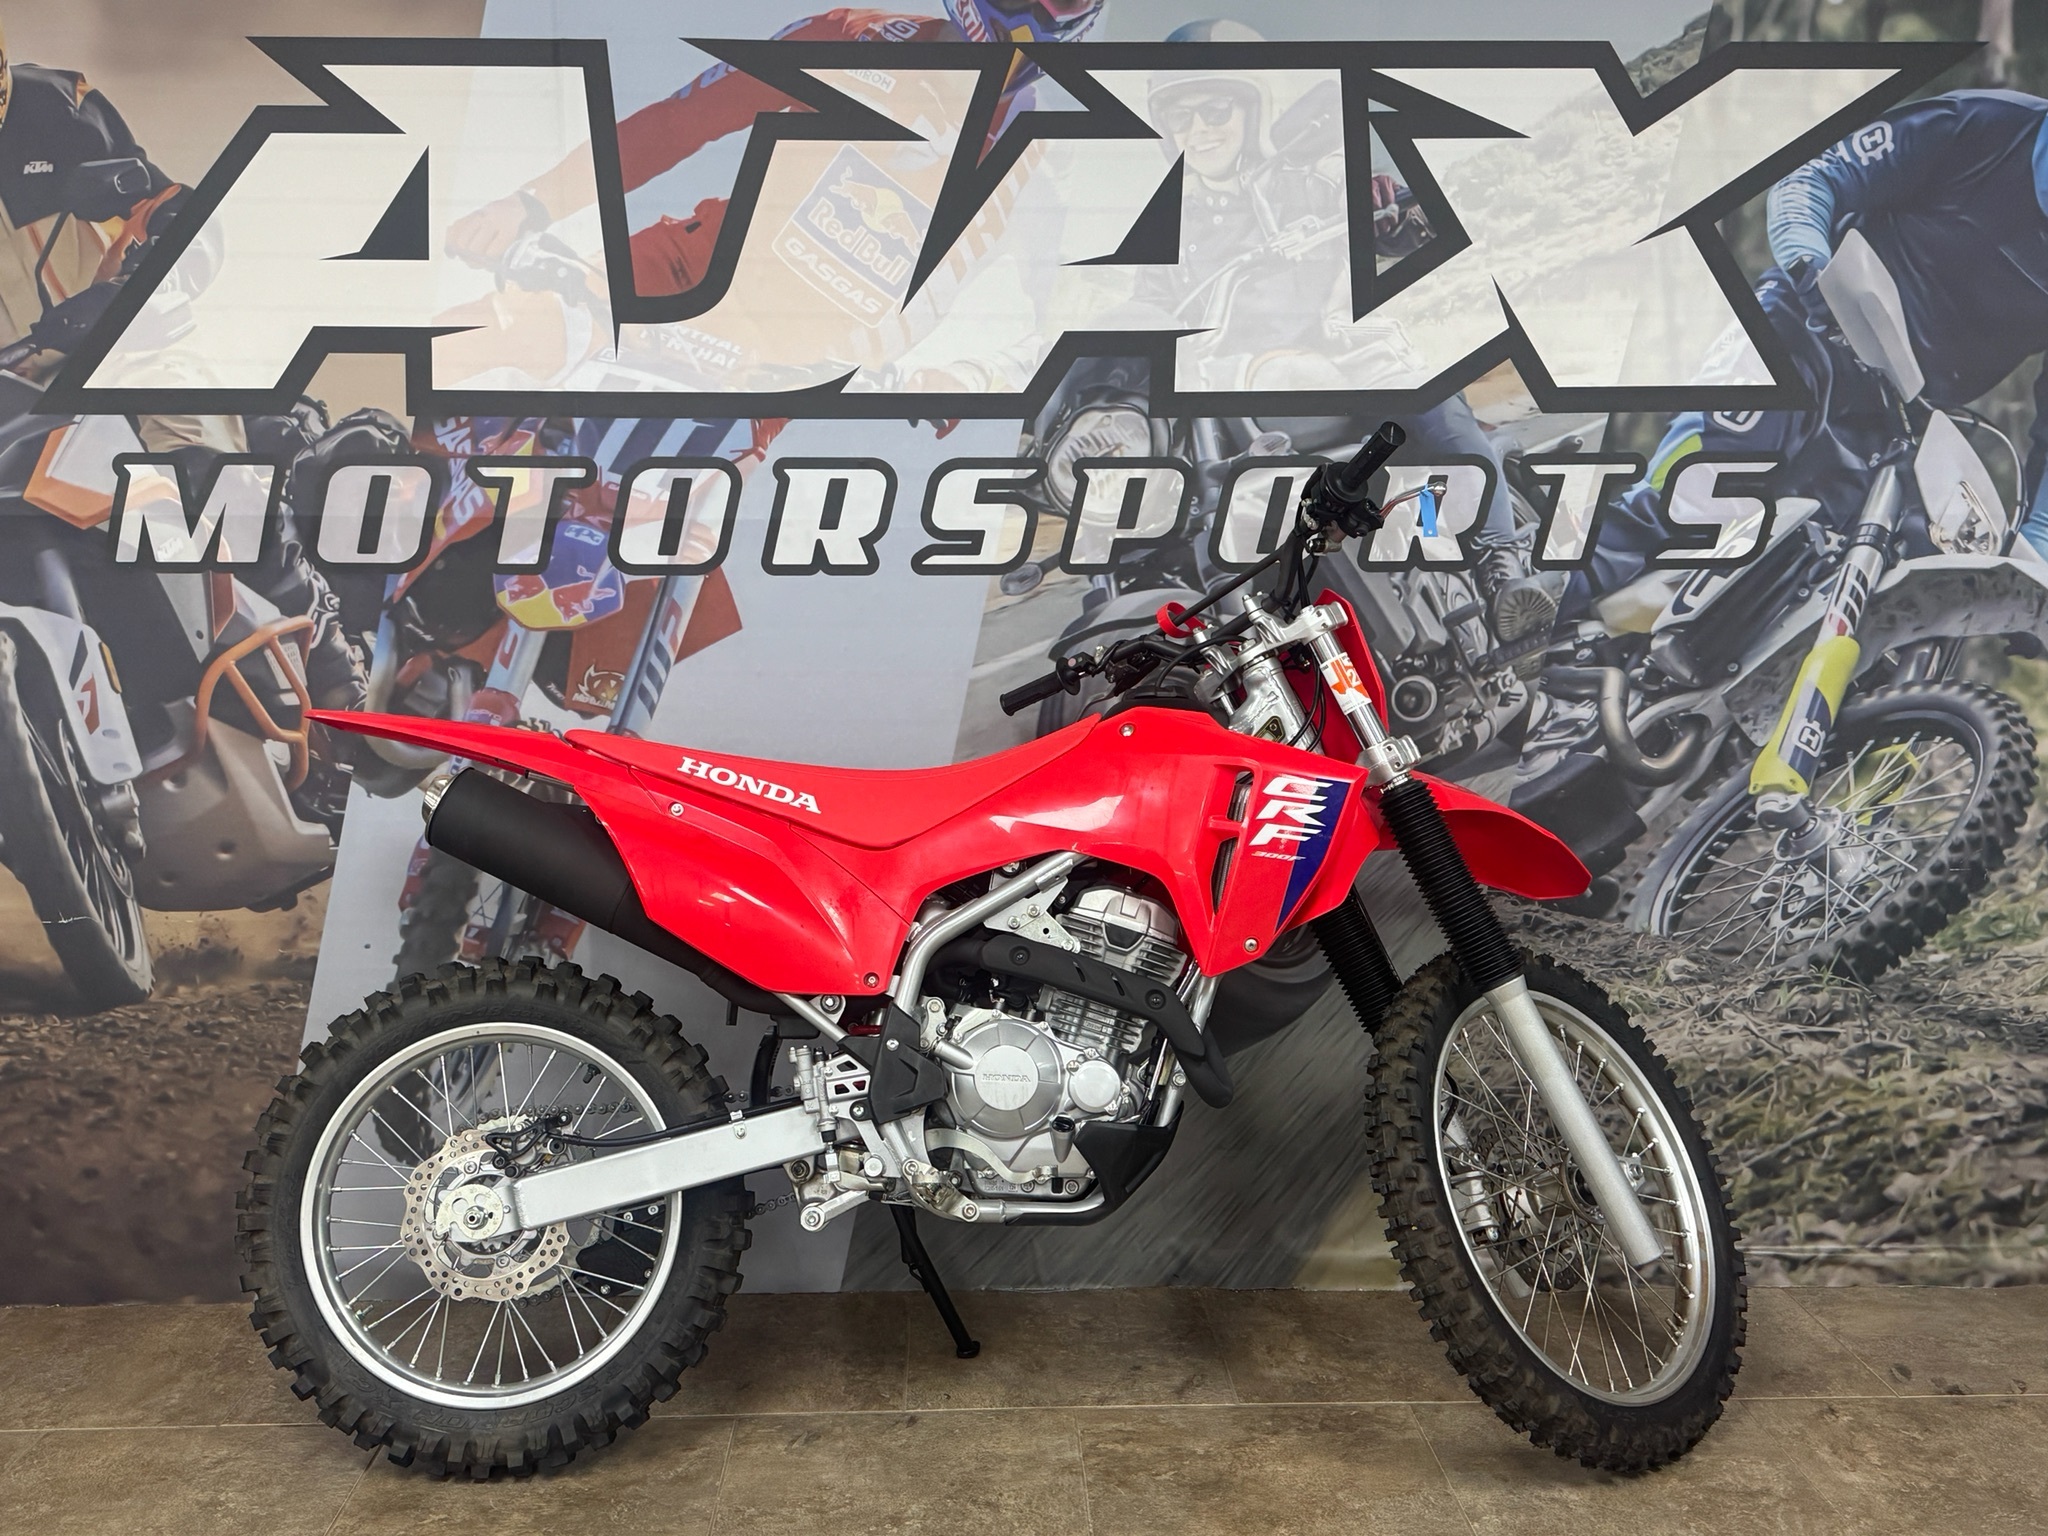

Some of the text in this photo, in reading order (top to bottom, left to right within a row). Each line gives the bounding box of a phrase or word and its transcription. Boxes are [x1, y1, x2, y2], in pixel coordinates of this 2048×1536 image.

[23, 161, 54, 174] KTM
[30, 36, 1988, 417] AJAX
[785, 238, 882, 314] GASGAS
[109, 453, 1786, 575] MOTORSPORTS
[677, 756, 821, 814] HONDA
[1249, 774, 1333, 846] CRF
[982, 1073, 1031, 1083] HONDA
